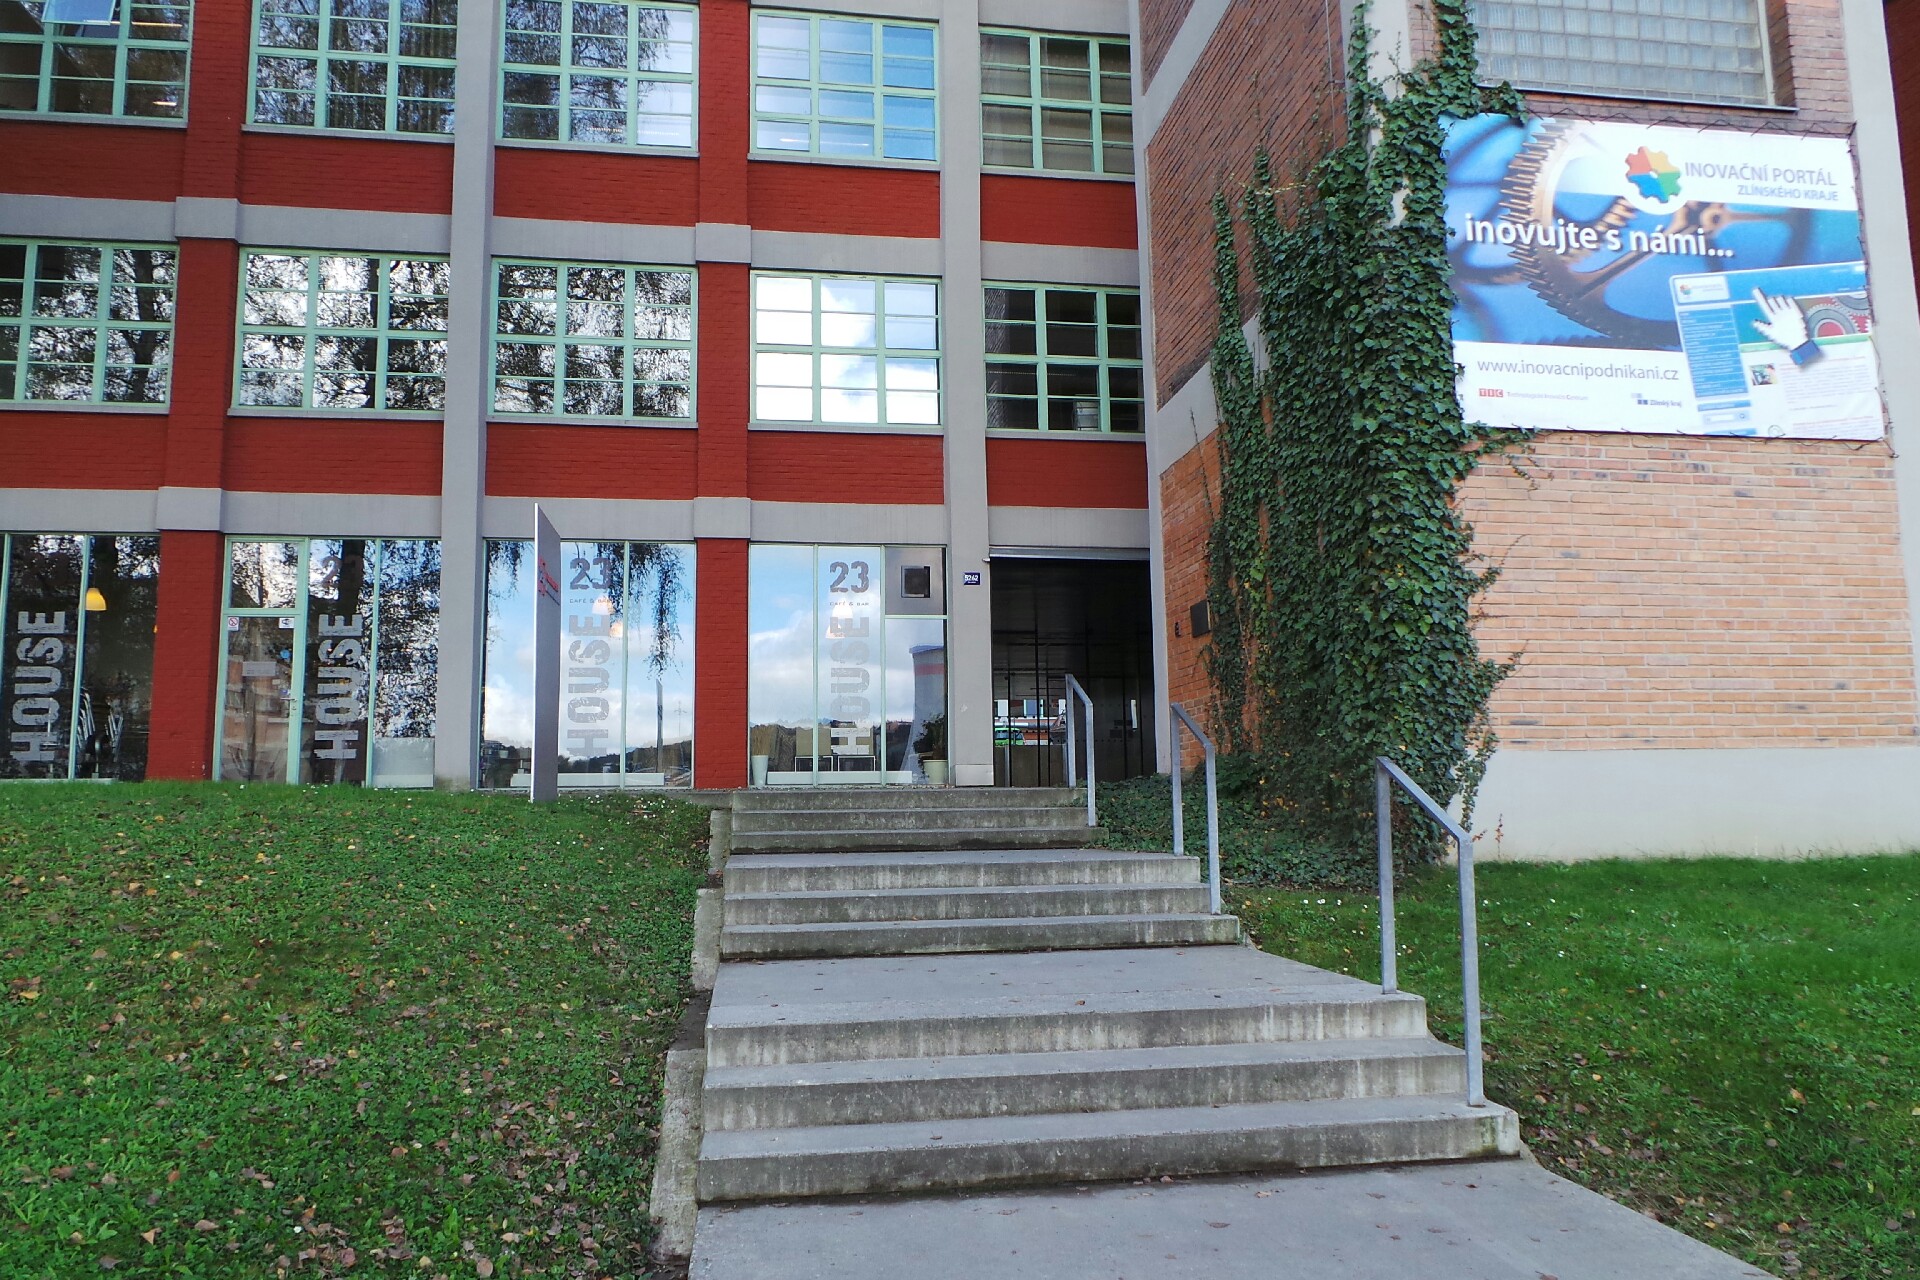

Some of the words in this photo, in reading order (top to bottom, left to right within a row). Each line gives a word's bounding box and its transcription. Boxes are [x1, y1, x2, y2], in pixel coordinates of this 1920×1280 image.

[1684, 161, 1768, 182] INOVAČNÍ
[1772, 167, 1838, 187] PORTÁL
[1804, 189, 1839, 201] KRAJE
[1465, 213, 1599, 255] inovujte
[1606, 228, 1620, 251] s
[1629, 224, 1735, 258] námi...
[1476, 359, 1680, 380] www.inovacnipodnikani.cz
[569, 557, 611, 590] 23
[829, 560, 870, 594] 23
[10, 610, 66, 762] HOUSE
[314, 613, 364, 760] HOUSE
[567, 614, 611, 757] HOUSE
[829, 616, 871, 756] HOUSE
